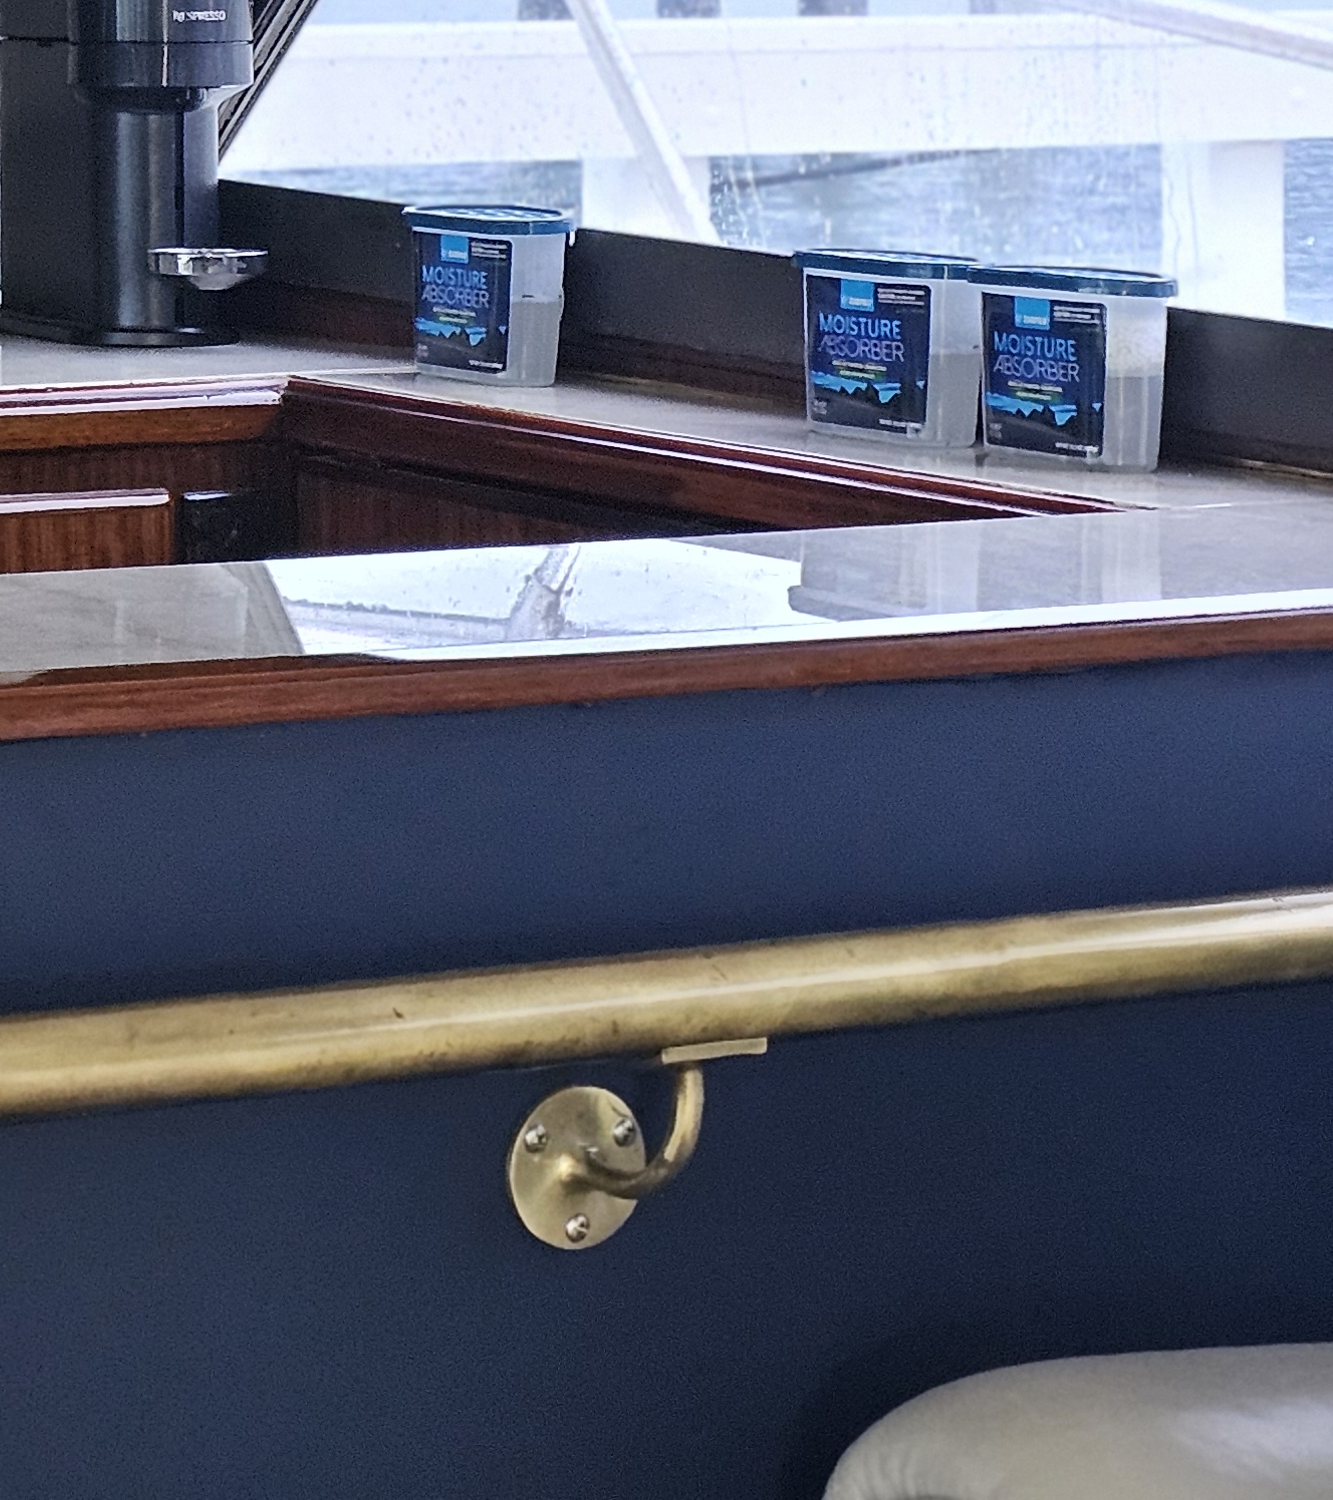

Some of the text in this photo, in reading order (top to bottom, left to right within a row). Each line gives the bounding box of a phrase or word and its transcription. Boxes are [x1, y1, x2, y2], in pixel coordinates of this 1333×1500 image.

[421, 264, 488, 290] MOISTURE
[421, 283, 490, 309] ABSORBER
[818, 310, 902, 340] MOISTURE
[817, 334, 904, 362] ABSORBER
[994, 330, 1077, 361] MOISTURE
[993, 354, 1080, 383] ABSORBER
